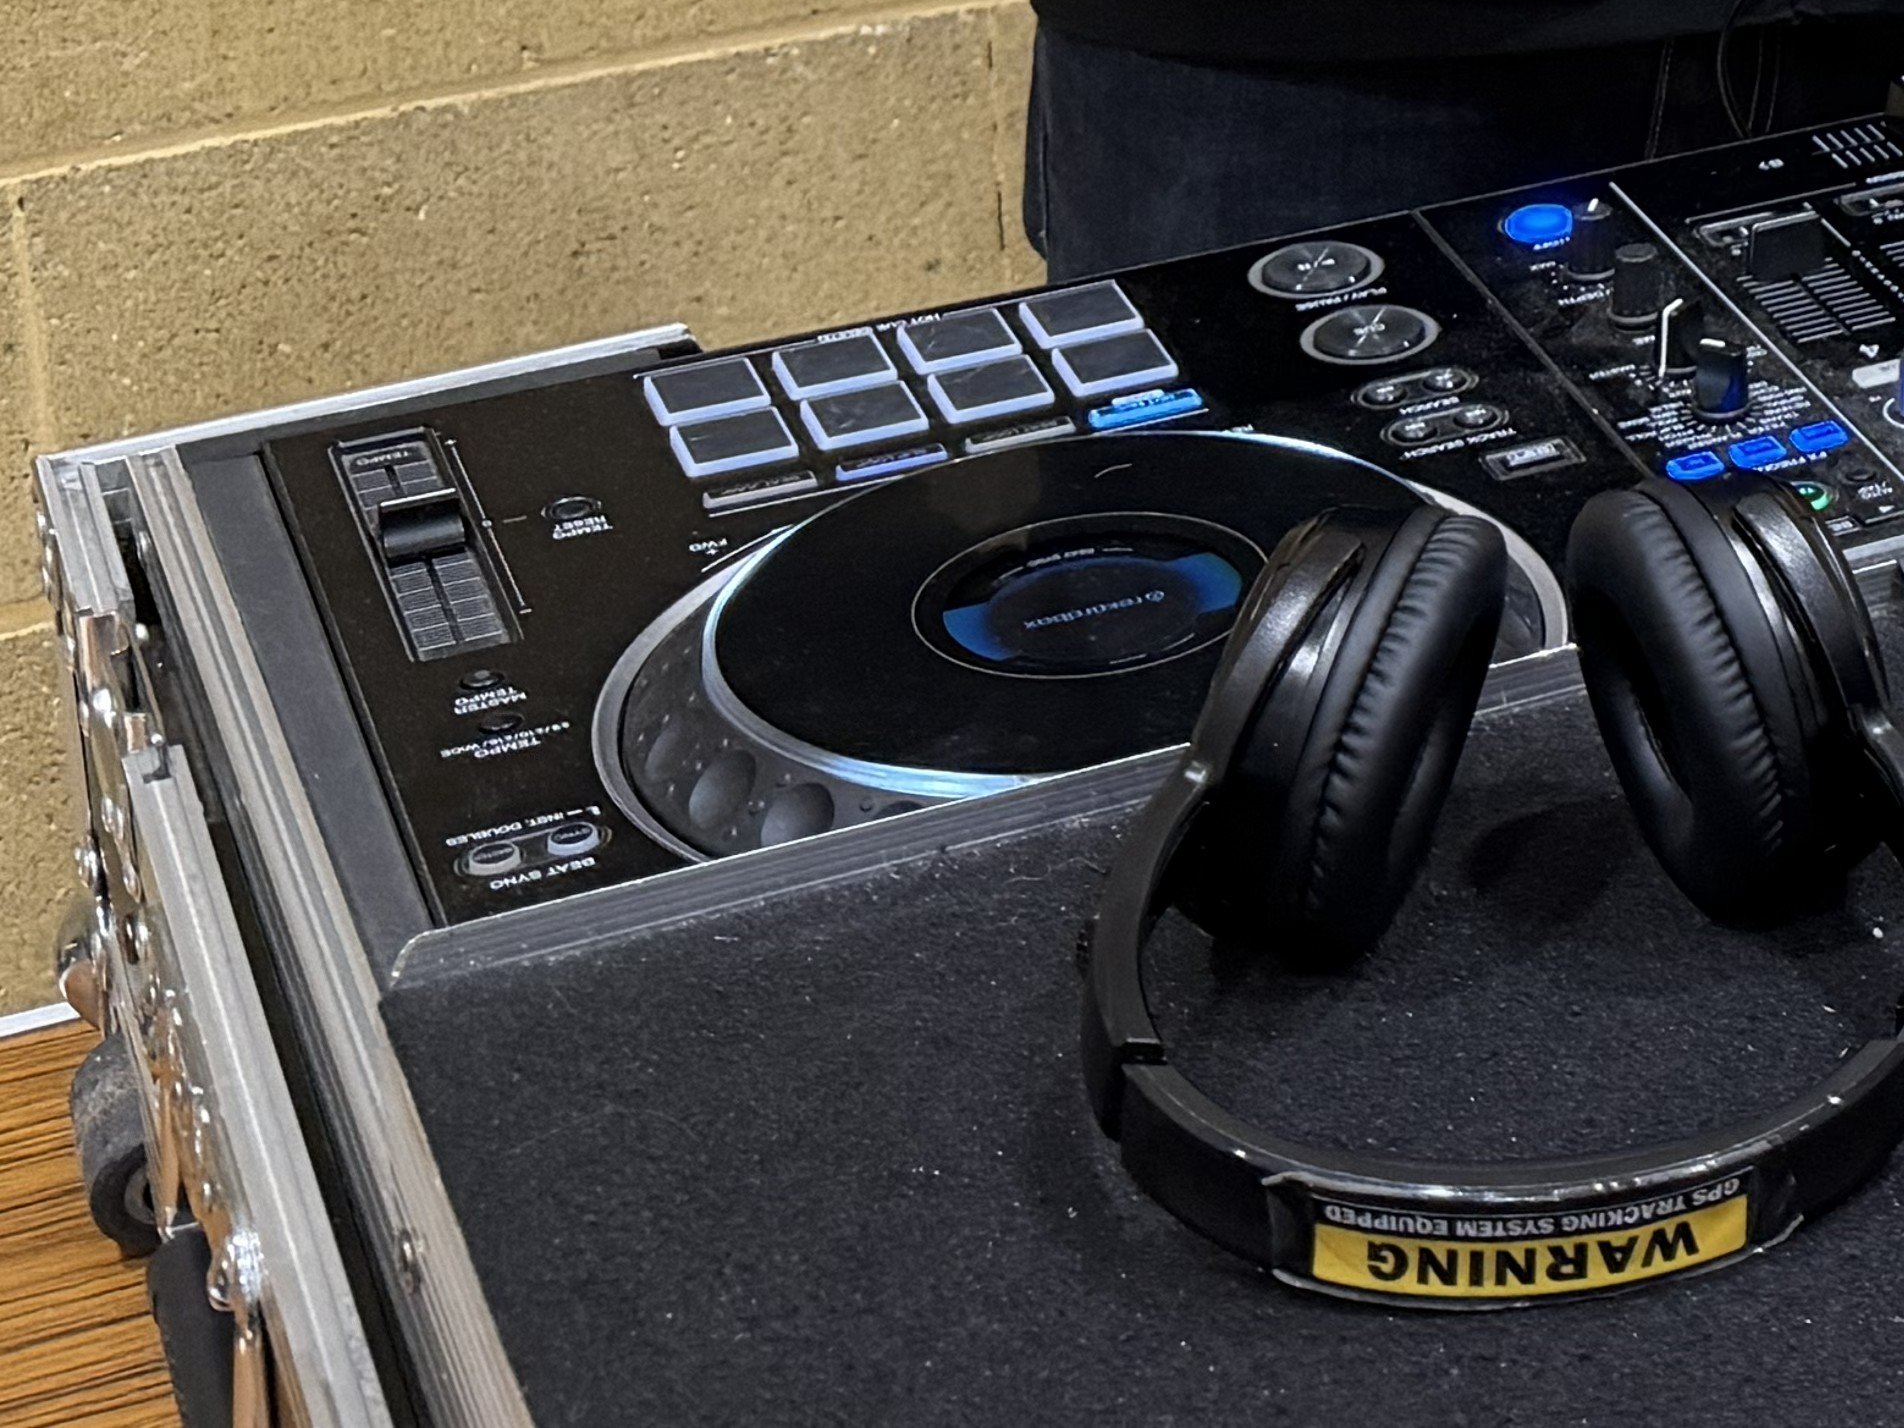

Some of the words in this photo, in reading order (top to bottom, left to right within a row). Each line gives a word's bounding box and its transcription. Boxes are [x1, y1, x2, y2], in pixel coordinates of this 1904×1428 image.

[356, 451, 410, 467] TEMPO
[552, 523, 613, 540] TEMPO
[1022, 596, 1143, 631] rekordbox
[454, 686, 516, 707] TEMPO
[454, 691, 527, 715] MASTER
[472, 737, 542, 758] TEMPO
[547, 856, 596, 878] BEAT
[489, 870, 542, 890] SYNC
[1692, 1177, 1741, 1206] GPS
[1323, 1202, 1449, 1236] EQUIPPED
[1560, 1197, 1686, 1232] TRACKING
[1455, 1215, 1556, 1239] SYSTEM
[1366, 1221, 1700, 1287] WARNING
